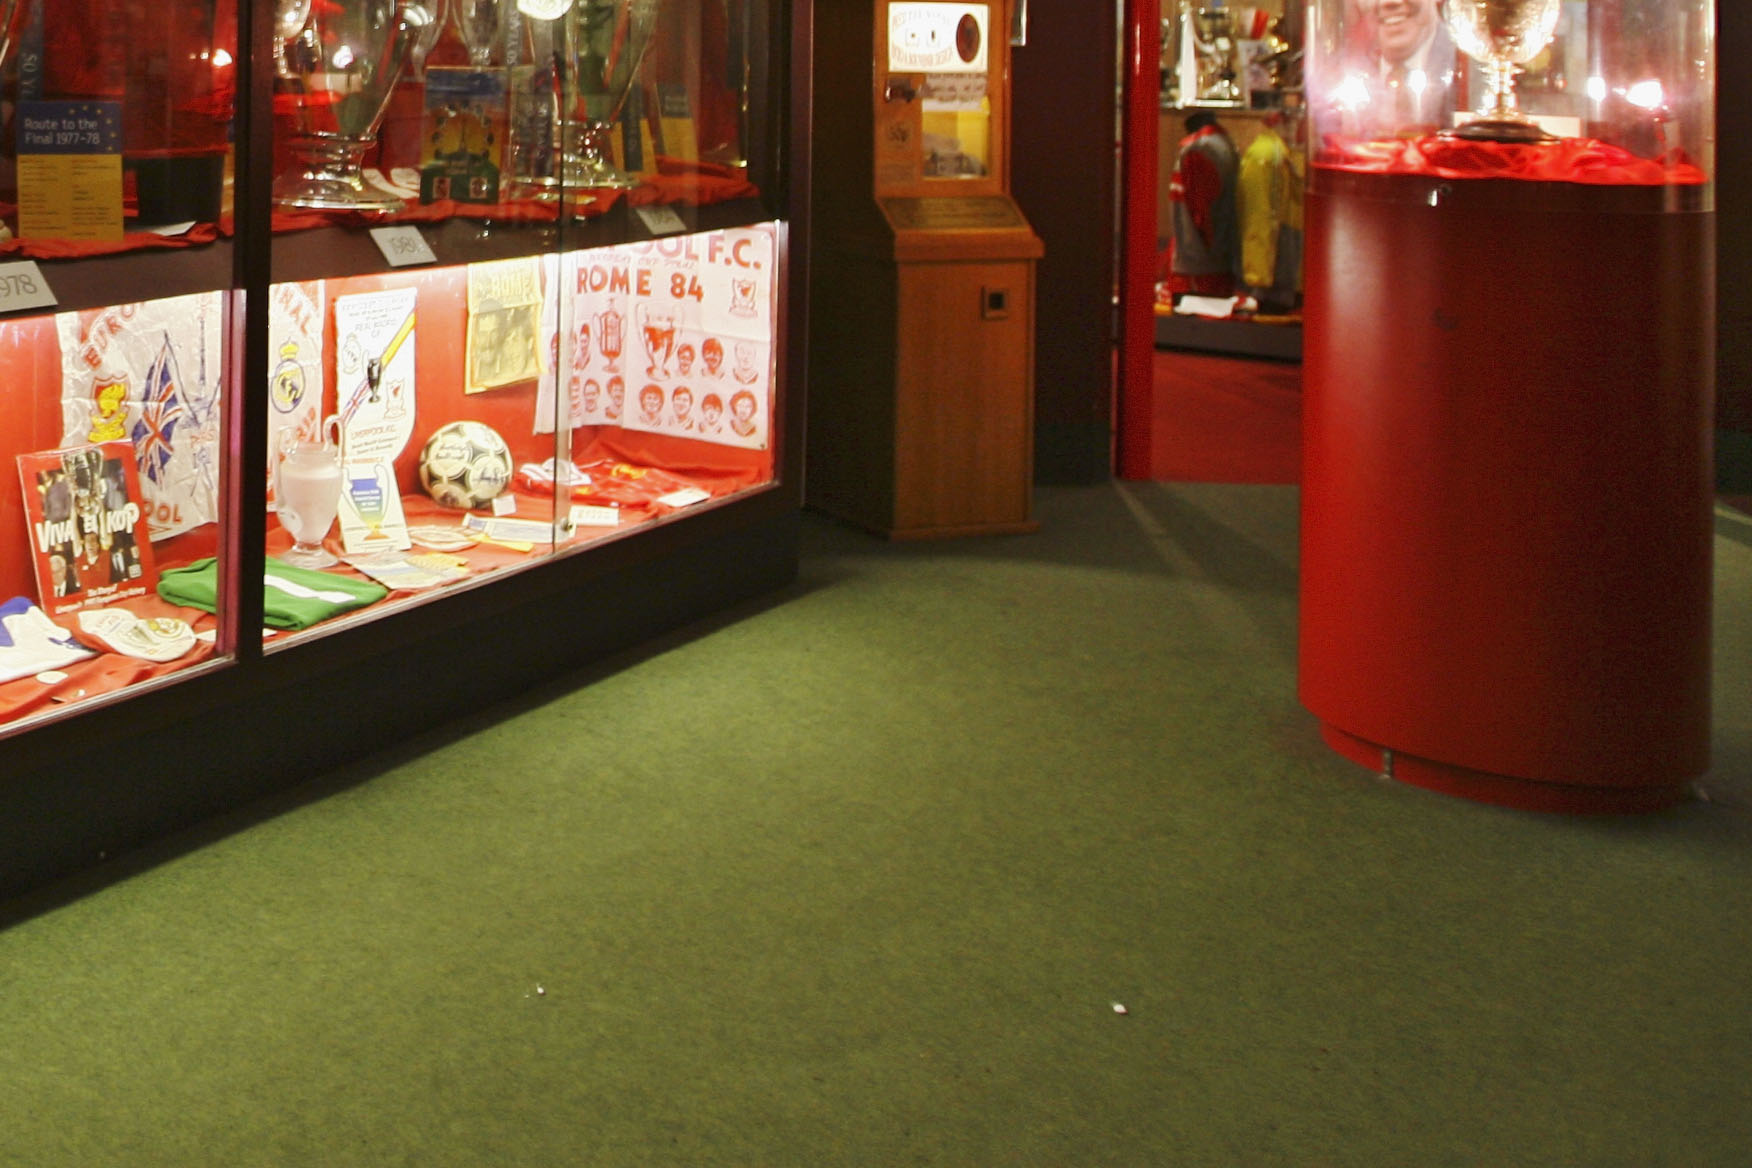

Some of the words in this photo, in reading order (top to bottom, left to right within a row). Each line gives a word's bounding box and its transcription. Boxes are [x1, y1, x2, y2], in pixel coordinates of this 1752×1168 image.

[24, 118, 58, 130] Route
[62, 118, 76, 130] to
[78, 118, 98, 130] the
[24, 133, 53, 144] Final
[56, 132, 100, 144] 1977-78
[576, 265, 652, 297] ROME
[670, 272, 704, 302] 84
